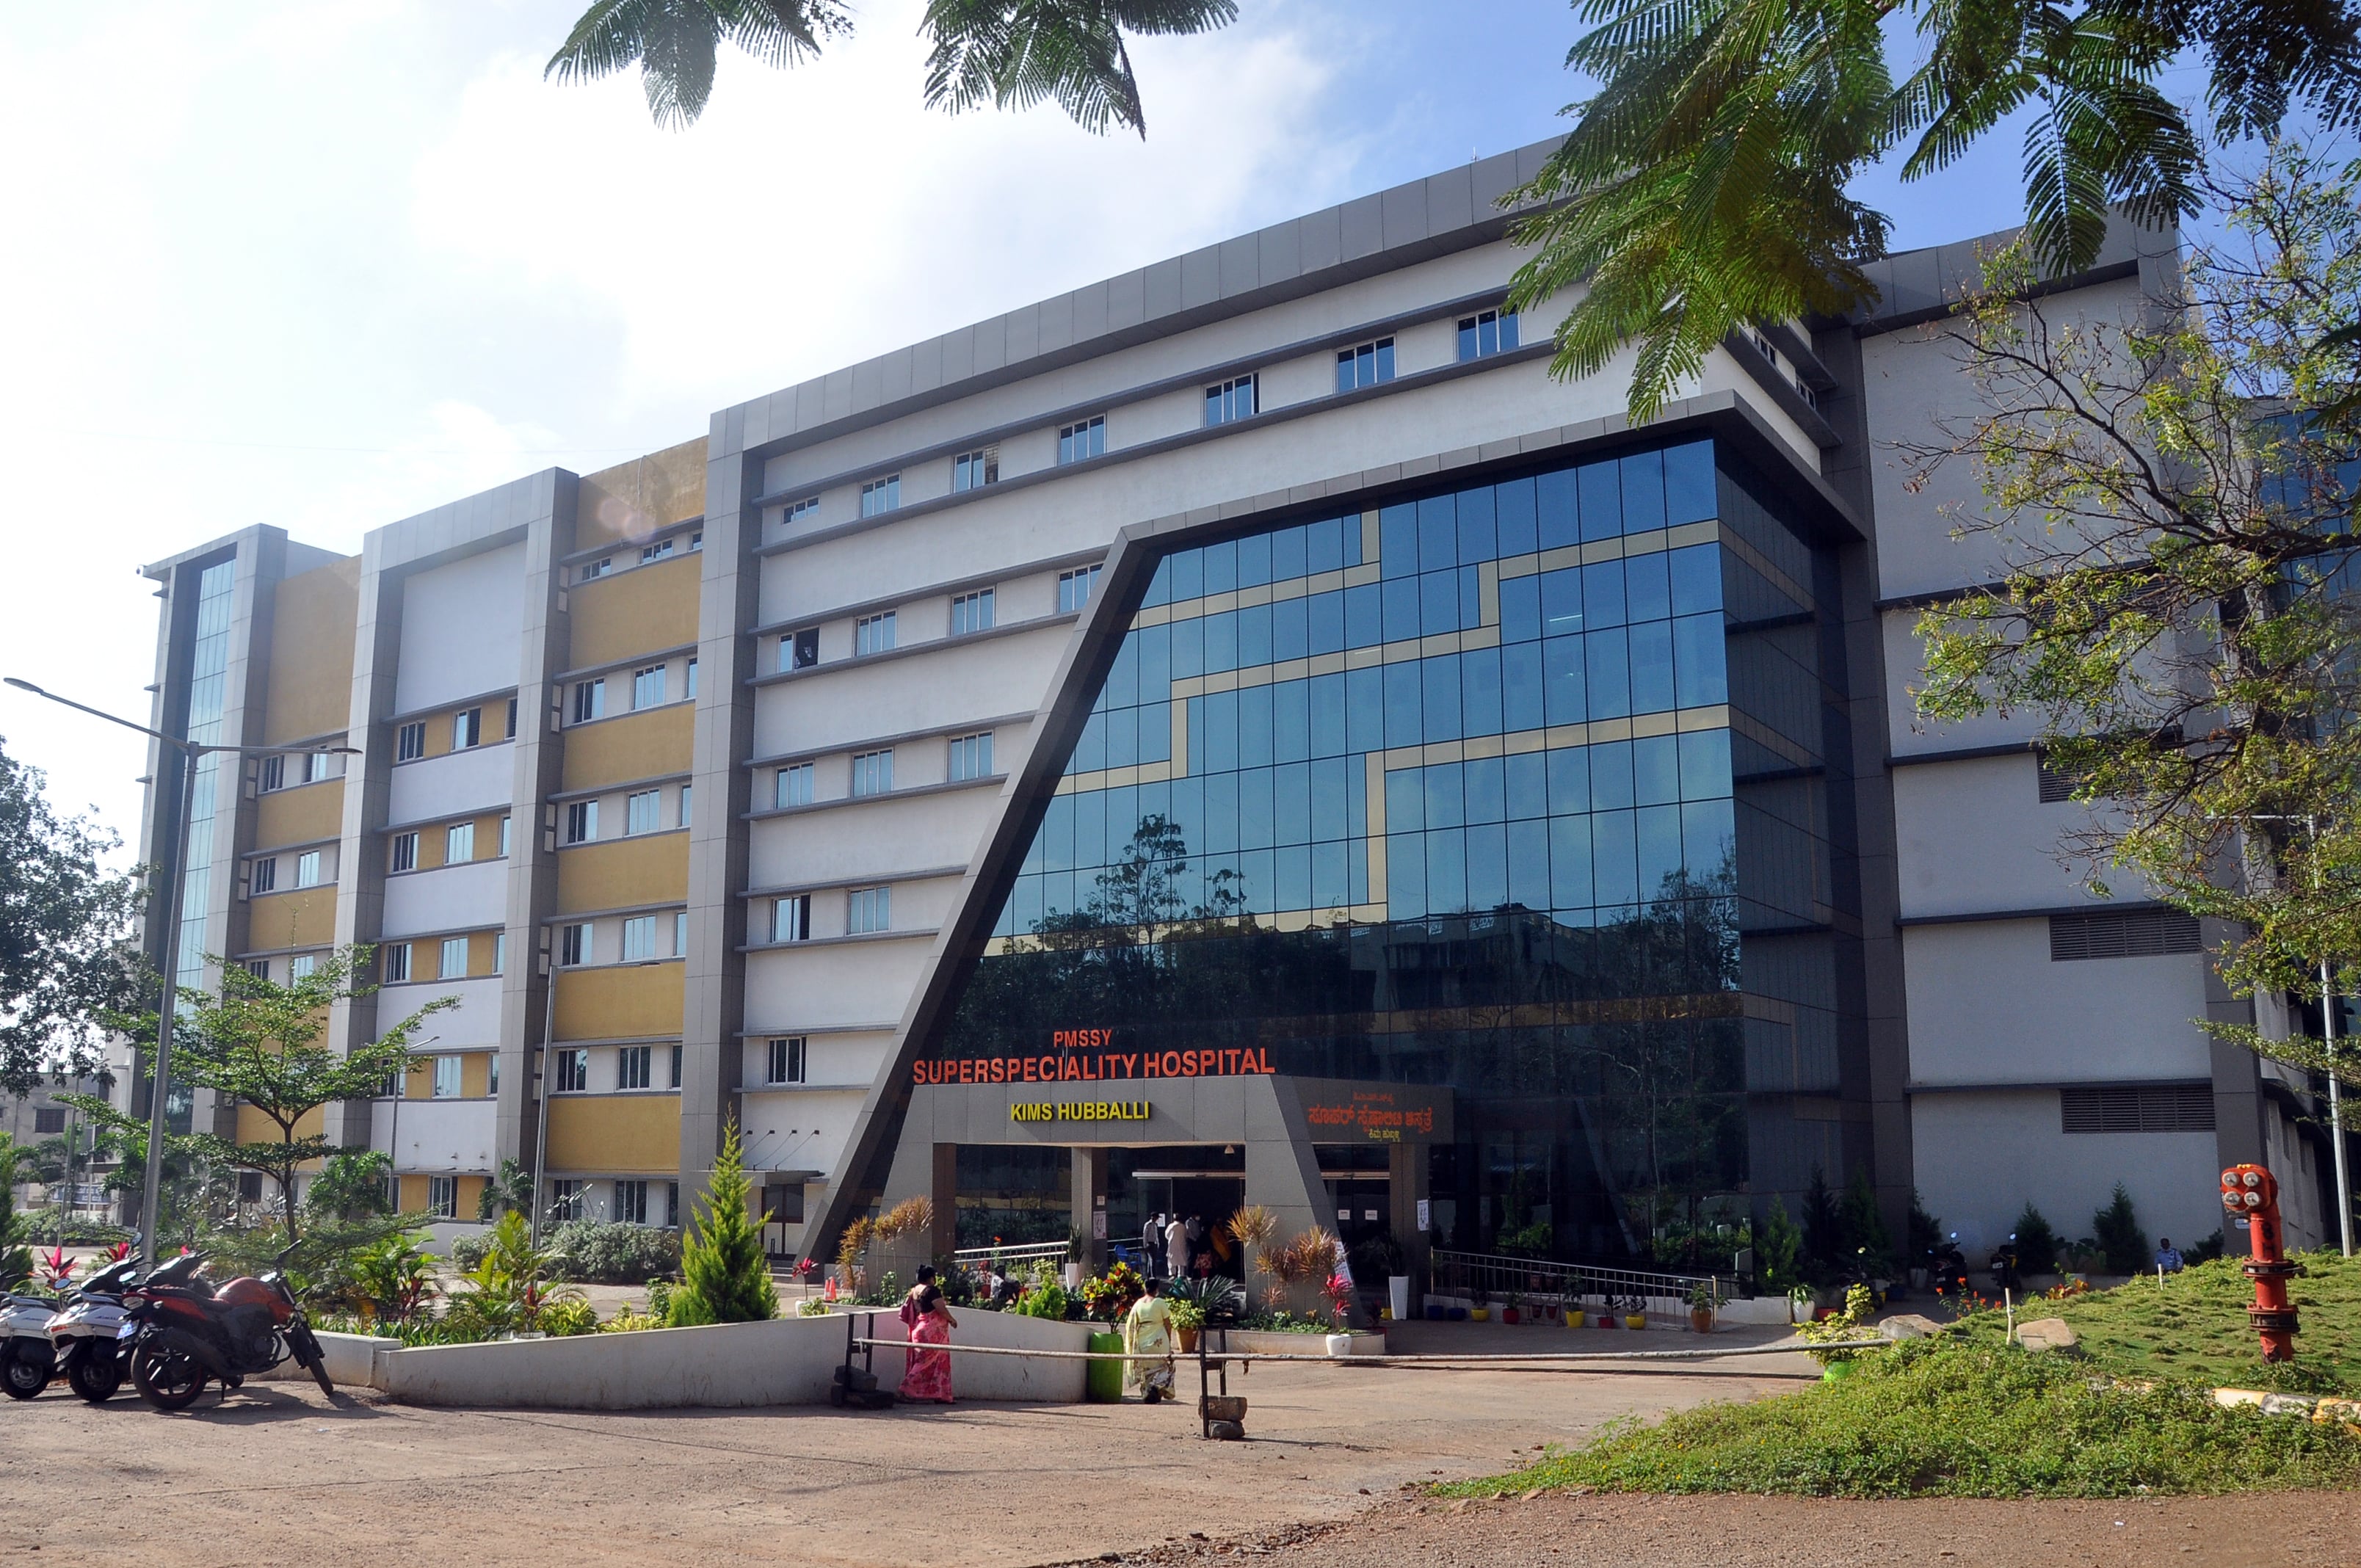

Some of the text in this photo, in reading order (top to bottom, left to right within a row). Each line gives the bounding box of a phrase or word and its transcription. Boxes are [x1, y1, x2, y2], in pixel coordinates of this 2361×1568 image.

[1053, 1029, 1112, 1048] PMSSY
[913, 1048, 1276, 1084] SUPERSPECIALITY HOSPITAL
[1010, 1101, 1150, 1121] KIMS HUBBALLI
